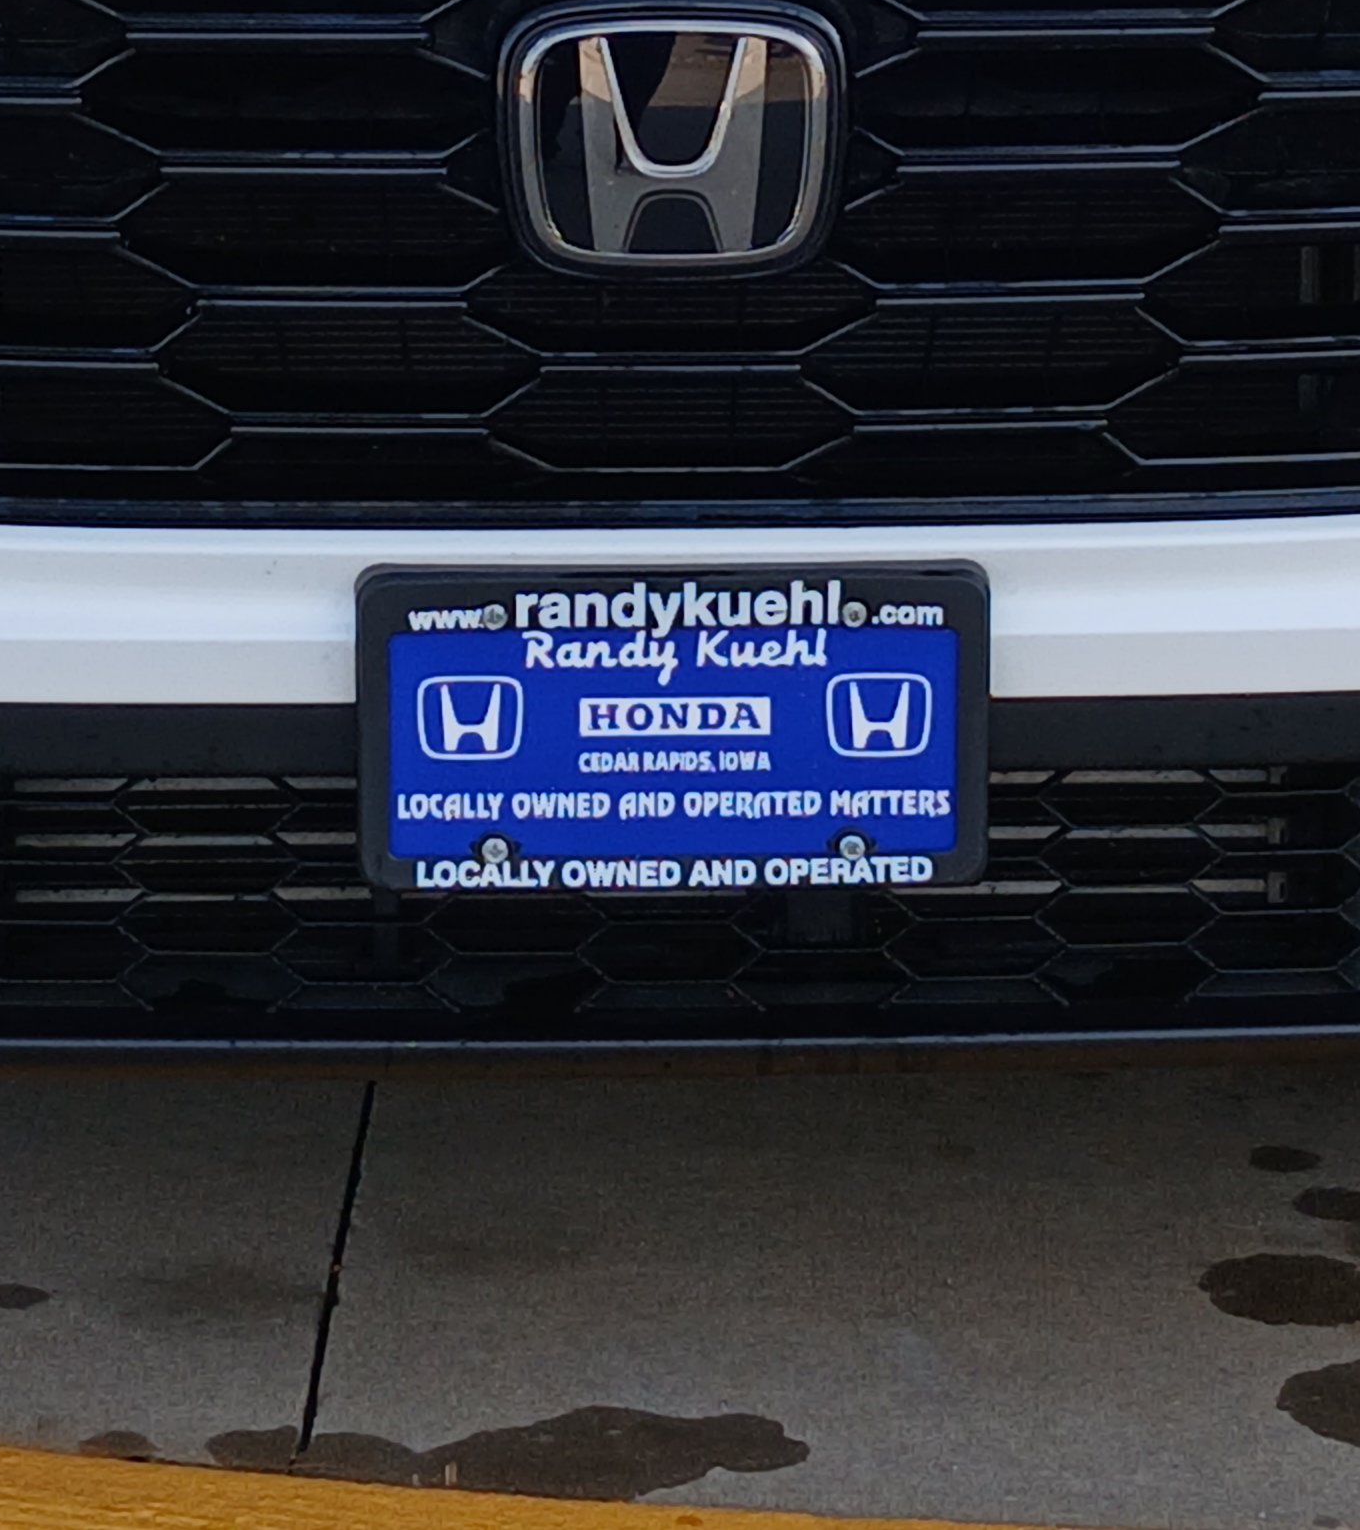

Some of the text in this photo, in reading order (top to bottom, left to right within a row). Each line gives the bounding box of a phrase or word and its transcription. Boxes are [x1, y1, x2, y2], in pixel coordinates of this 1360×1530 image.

[515, 579, 841, 638] randykuehl
[522, 628, 828, 687] Randy Kuehl
[588, 702, 761, 731] HONDA
[578, 750, 771, 773] CEDAR RAPIDS, IOWA
[397, 789, 951, 820] LOCALLY OWNED AND OPERATED MATTERS
[416, 856, 933, 888] LOCALLY OWNED AND OPERATED
